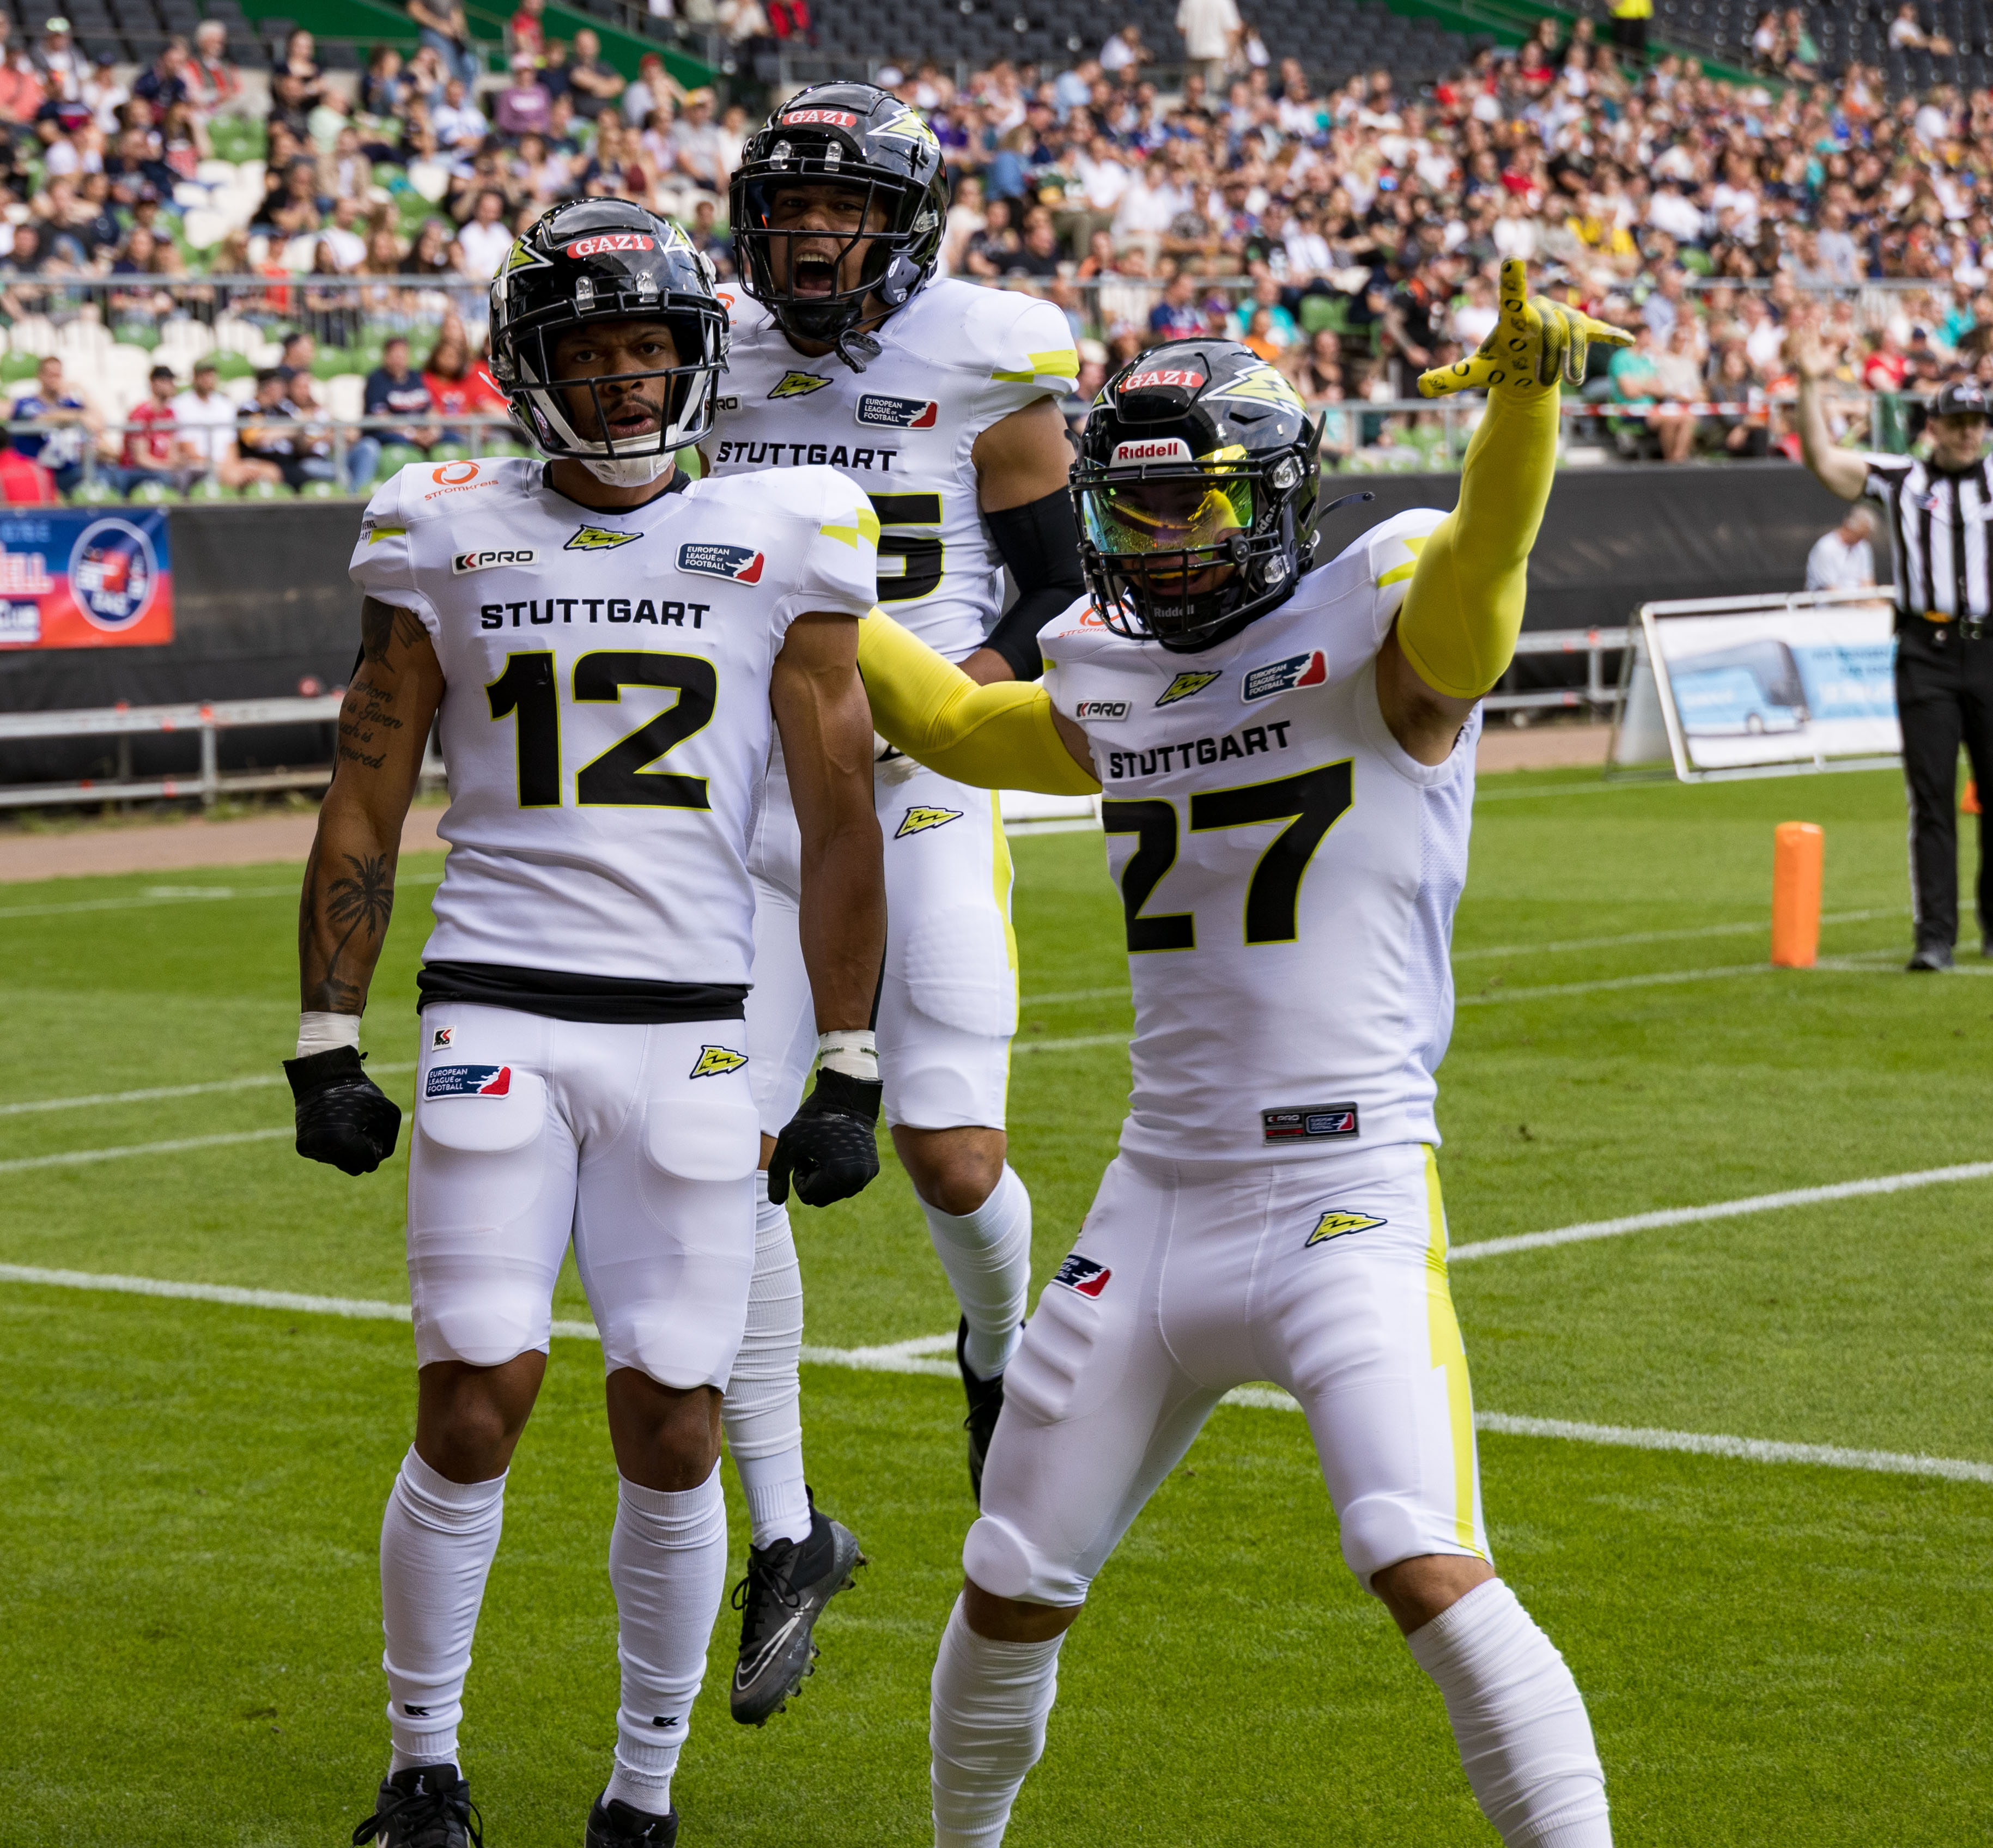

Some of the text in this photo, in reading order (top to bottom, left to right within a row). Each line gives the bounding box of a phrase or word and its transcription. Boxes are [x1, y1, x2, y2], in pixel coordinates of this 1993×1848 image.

[788, 111, 850, 126] GAZI
[575, 234, 647, 256] GAZI
[1126, 370, 1195, 390] GAZI
[864, 405, 890, 414] LEAGUE
[865, 398, 902, 409] EUROPEAN
[864, 412, 899, 422] FOOTBALL
[716, 441, 897, 472] STUTTGART
[1118, 442, 1178, 460] Riddell
[686, 553, 716, 561] LEAGUE
[687, 546, 730, 556] EUROPEAN
[685, 559, 725, 571] FOOTBALL
[481, 599, 710, 629] STUTTGART
[1250, 663, 1287, 681] EUROPEAN
[1248, 679, 1284, 696] FOOTBALL
[1249, 674, 1275, 688] LEAGUE
[484, 649, 719, 812] 12
[1110, 720, 1291, 779] STUTTGART
[1102, 756, 1354, 955] 27
[429, 1068, 468, 1078] EUROPEAN
[429, 1076, 454, 1085] LEAGUE
[427, 1083, 463, 1093] FOOTBALL
